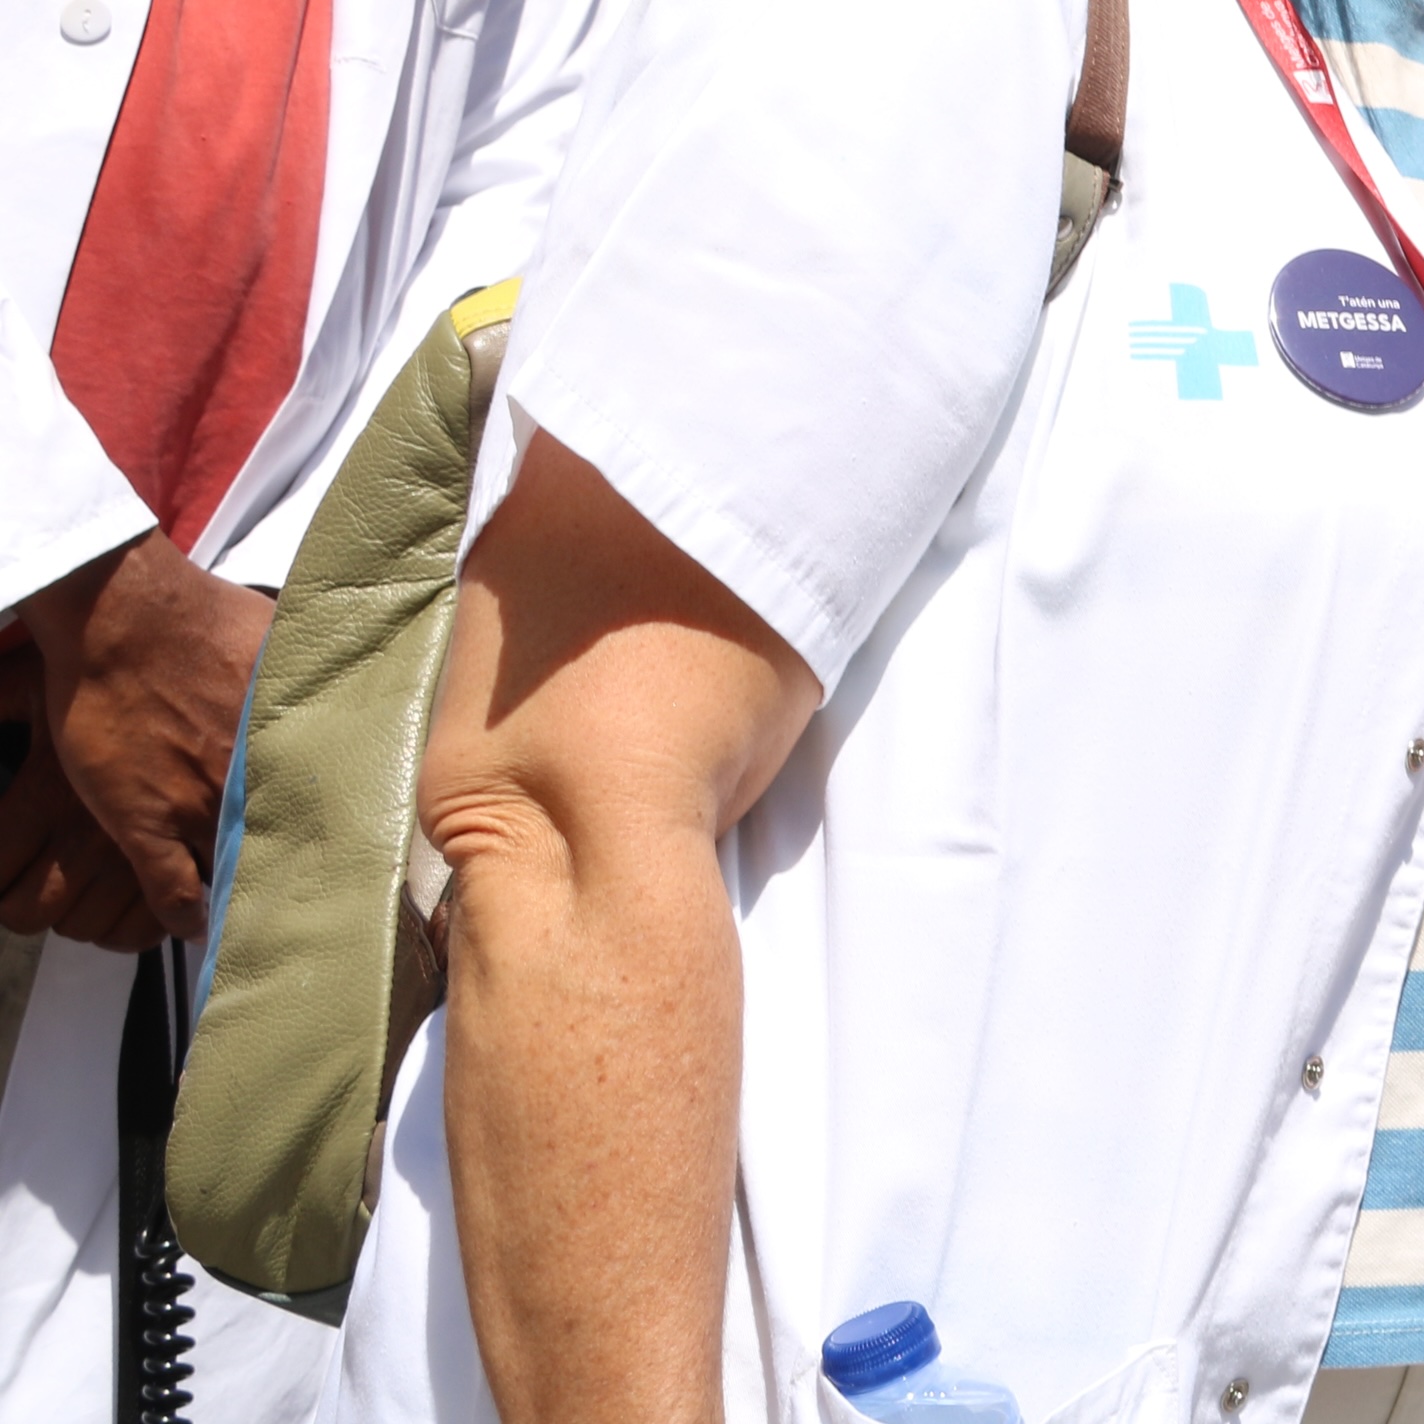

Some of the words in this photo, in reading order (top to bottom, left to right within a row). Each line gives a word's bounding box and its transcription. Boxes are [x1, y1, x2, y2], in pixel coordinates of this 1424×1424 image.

[1337, 295, 1376, 309] T'atén
[1377, 297, 1401, 310] una
[1297, 310, 1407, 333] METGESSA
